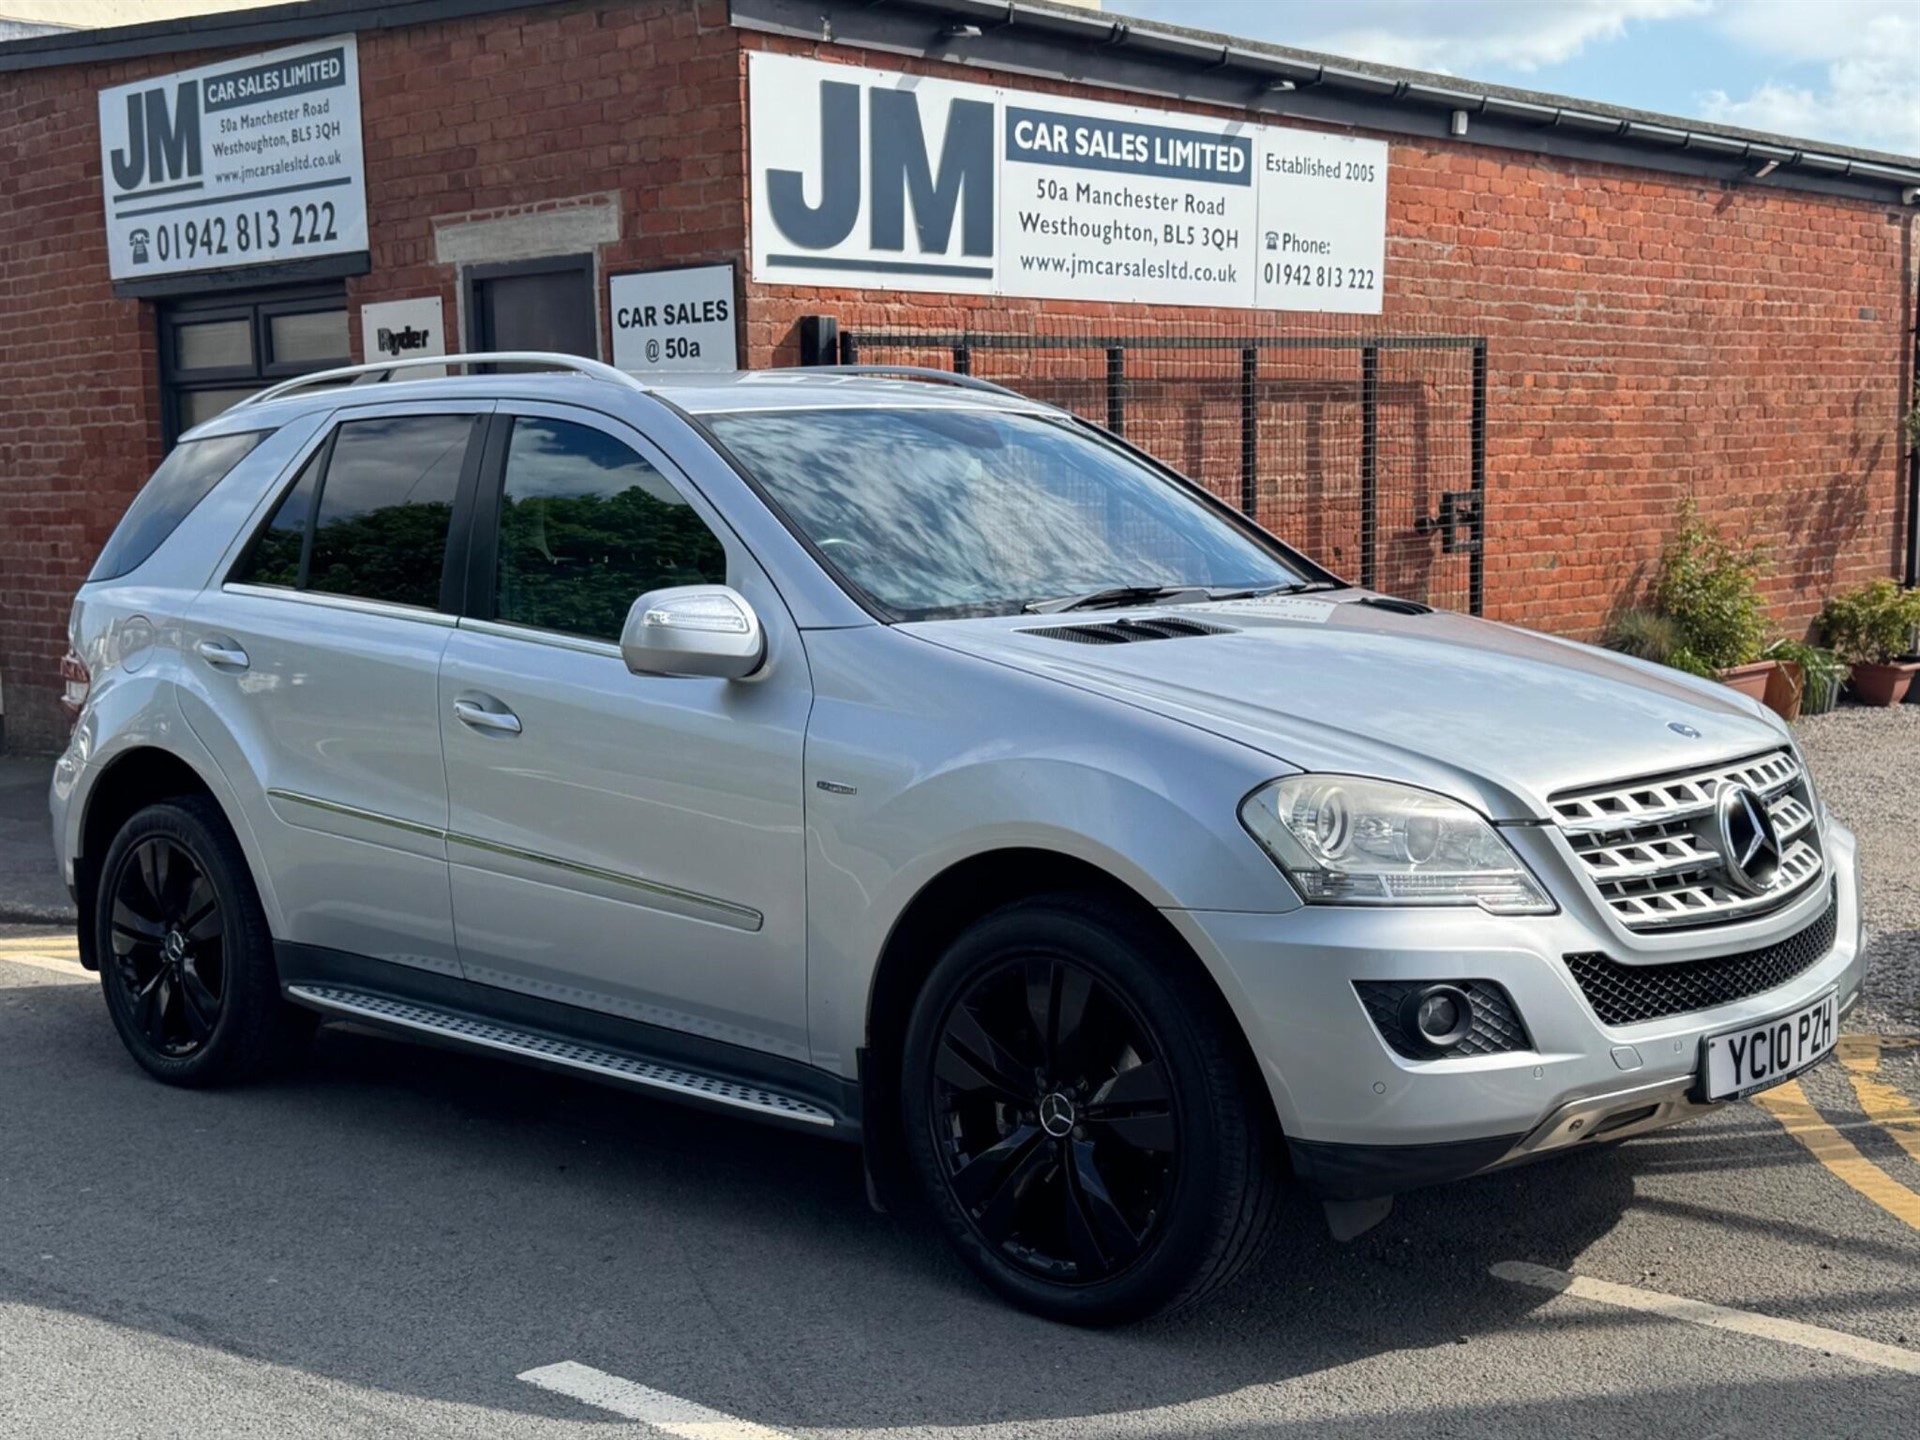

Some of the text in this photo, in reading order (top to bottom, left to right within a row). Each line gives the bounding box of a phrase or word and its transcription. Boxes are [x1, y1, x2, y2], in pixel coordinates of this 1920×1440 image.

[208, 58, 340, 103] CAR SALES LIMITED
[220, 98, 330, 133] 50a Manchester Road
[110, 79, 203, 191] JM
[212, 120, 341, 157] Westhoughton, BL5 3QH
[1014, 120, 1245, 173] CAR SALES LIMITED
[215, 149, 342, 183] www.jmcarsalesltd.co.uk
[766, 79, 994, 257] JM
[1266, 153, 1375, 182] Established 2005
[1037, 179, 1225, 216] 50a Manchester Road
[157, 201, 338, 262] 01942 813 222
[1019, 211, 1239, 251] Westhoughton, BL5 3QH
[1282, 233, 1331, 254] Phone:
[1020, 253, 1237, 283] www.jmcarsalesltd.co.uk
[1264, 262, 1374, 290] 01942 813 222
[617, 300, 728, 329] CAR SALES
[377, 326, 429, 356] Ryder
[645, 337, 700, 363] @ 50a
[1728, 999, 1832, 1086] YC10 PZH
